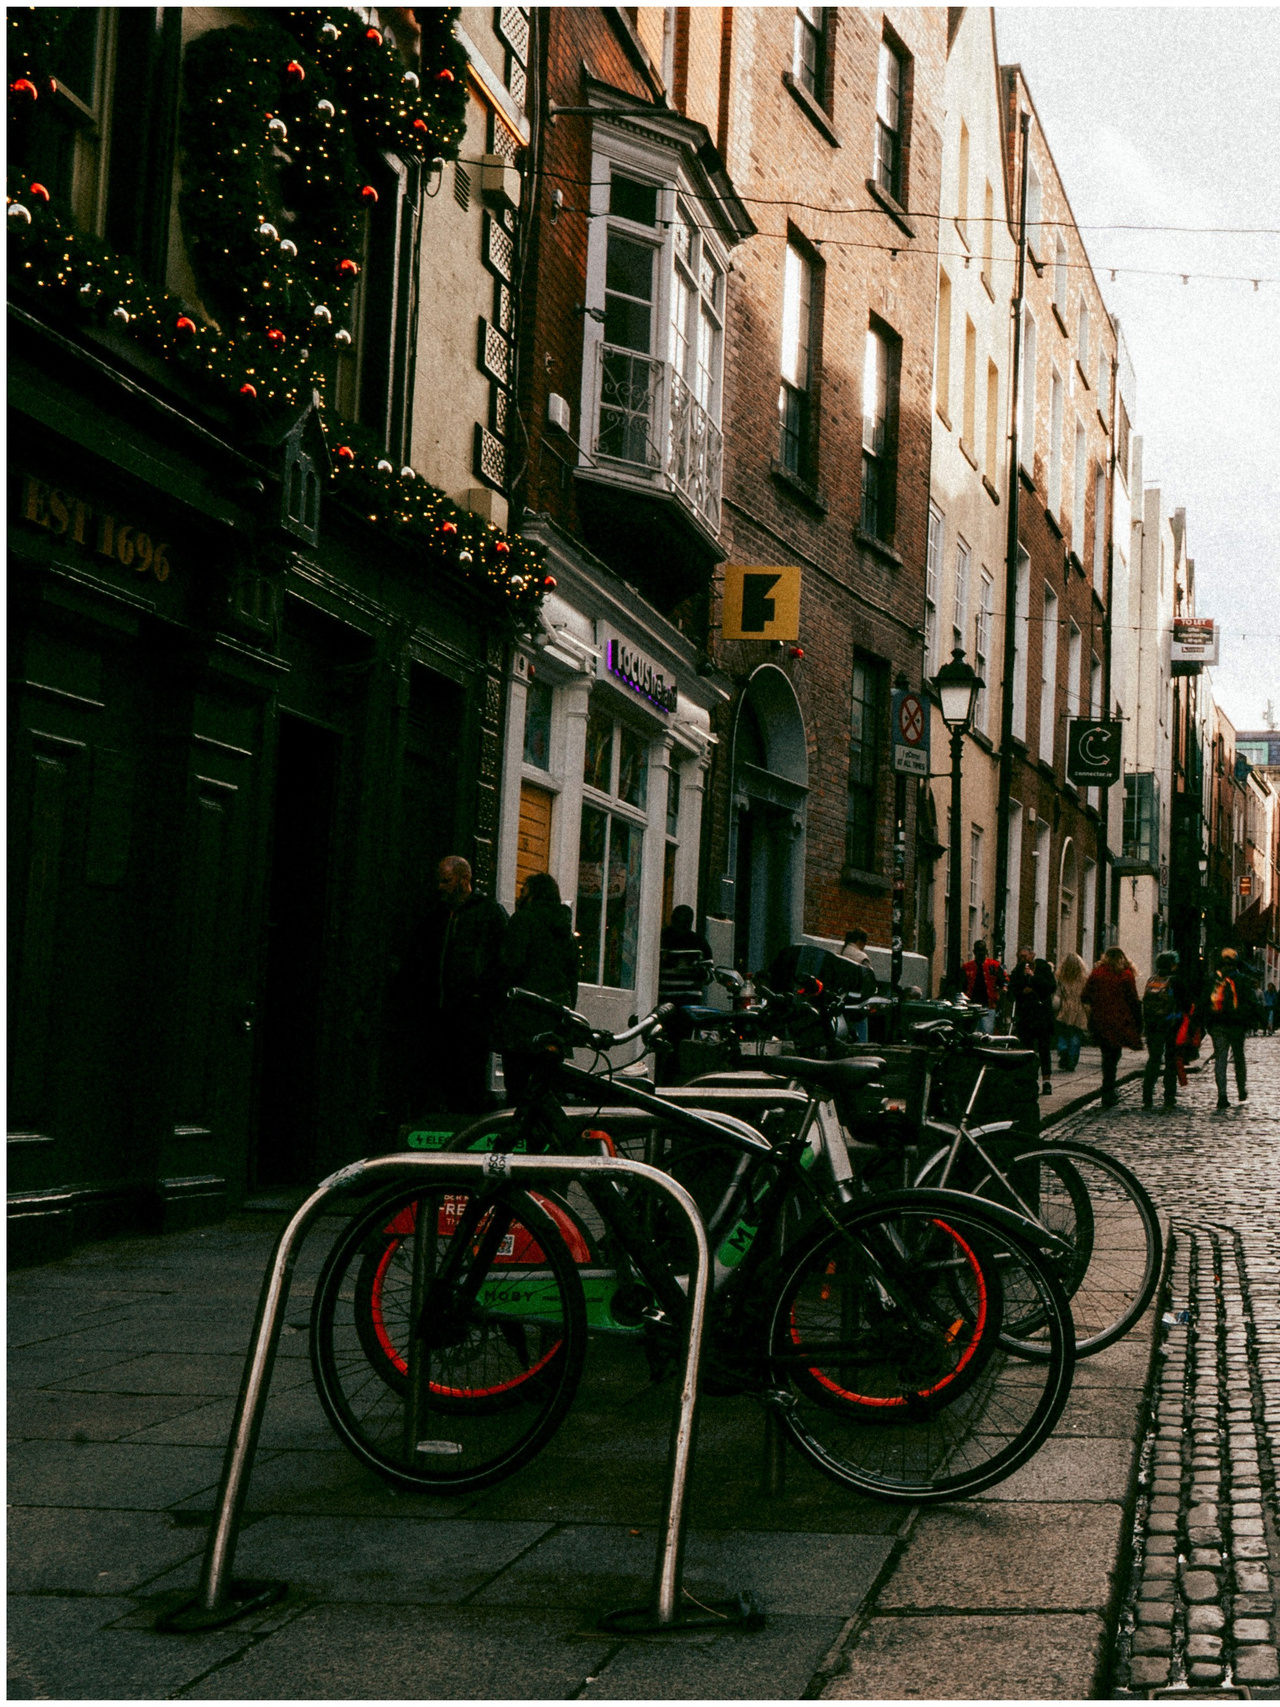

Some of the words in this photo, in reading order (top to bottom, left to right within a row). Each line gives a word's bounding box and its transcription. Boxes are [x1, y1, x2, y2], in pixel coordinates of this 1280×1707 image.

[24, 476, 92, 545] EST
[99, 513, 171, 574] 1696
[483, 1289, 534, 1302] MOBY
